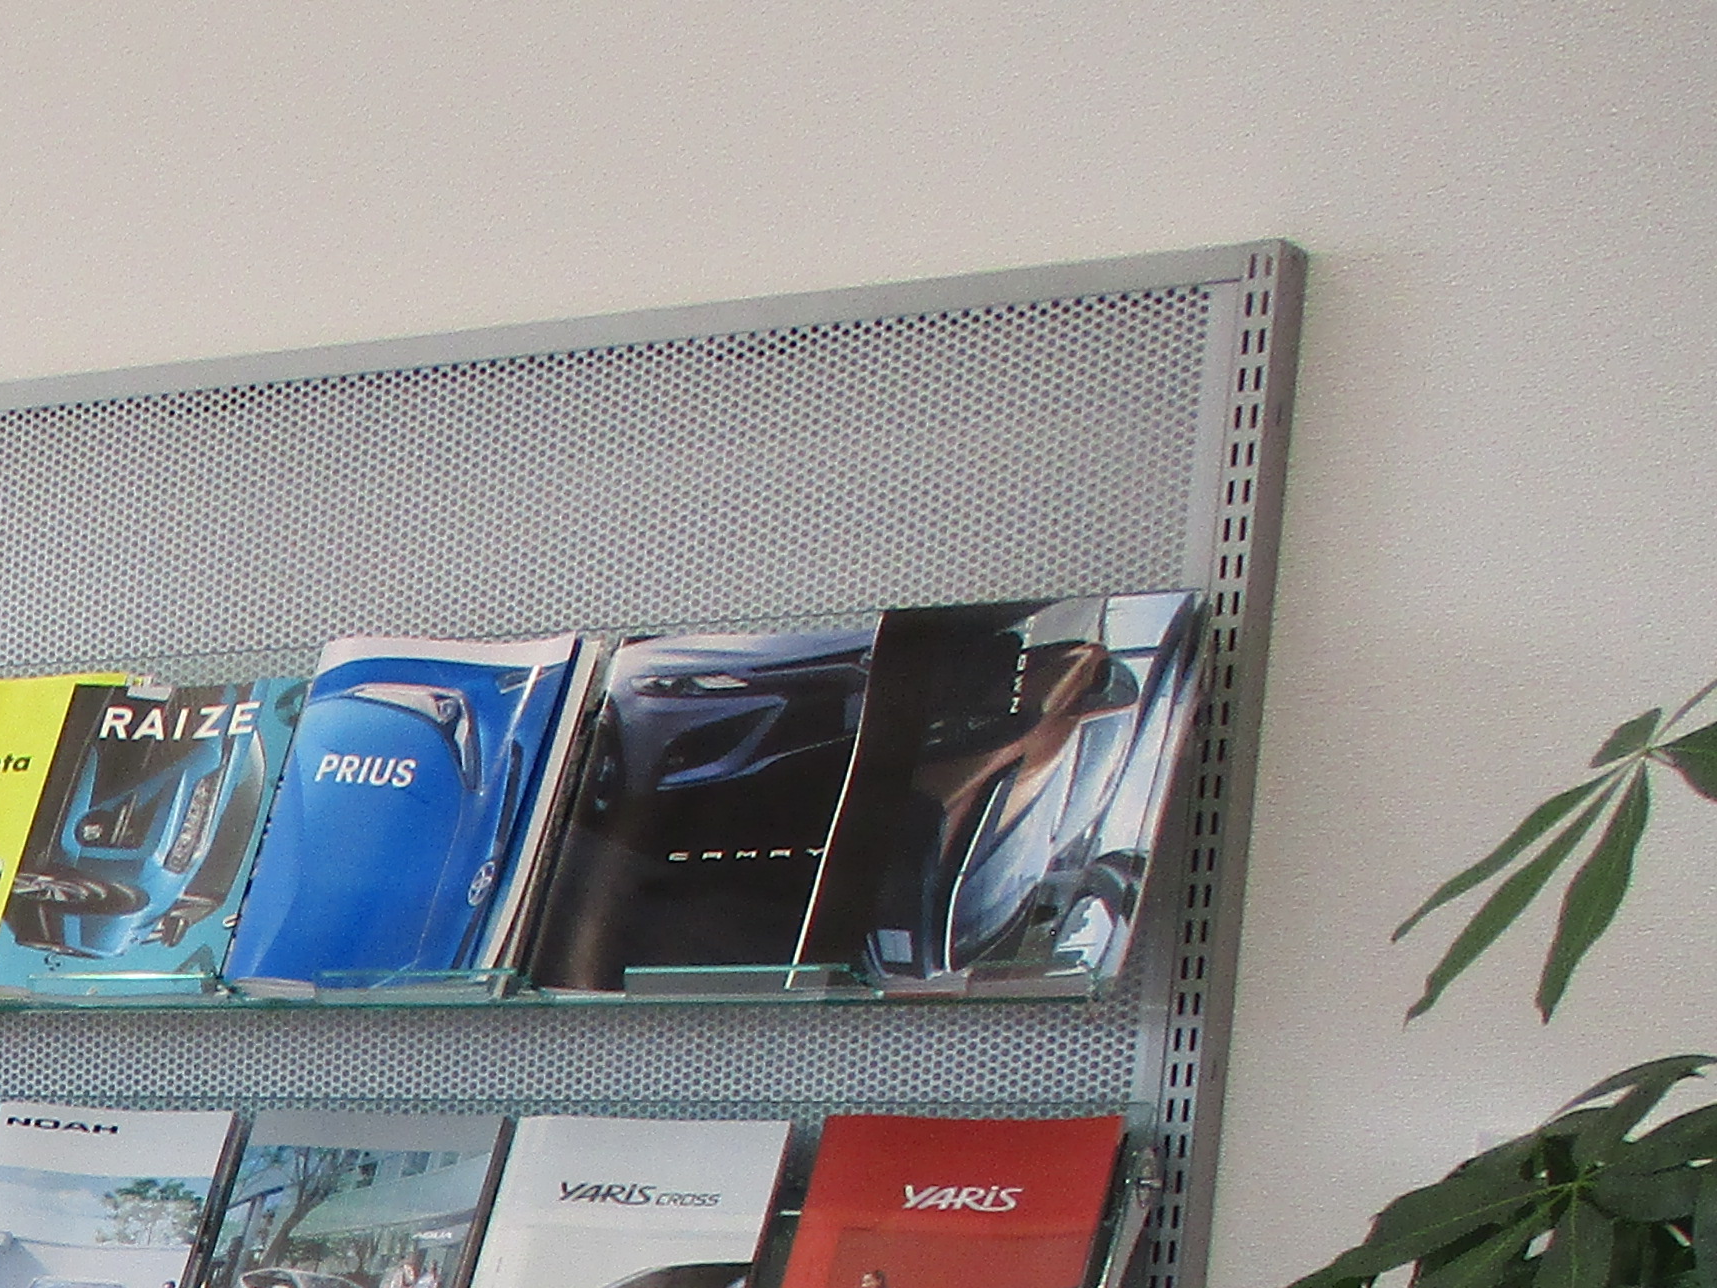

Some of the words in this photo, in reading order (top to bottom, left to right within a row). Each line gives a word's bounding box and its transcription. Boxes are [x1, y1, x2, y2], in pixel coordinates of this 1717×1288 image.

[99, 701, 261, 741] RAIZE
[314, 754, 417, 788] PRIUS
[668, 848, 825, 862] CAMRY
[6, 1116, 120, 1135] NOAH
[654, 1192, 721, 1208] CROSS
